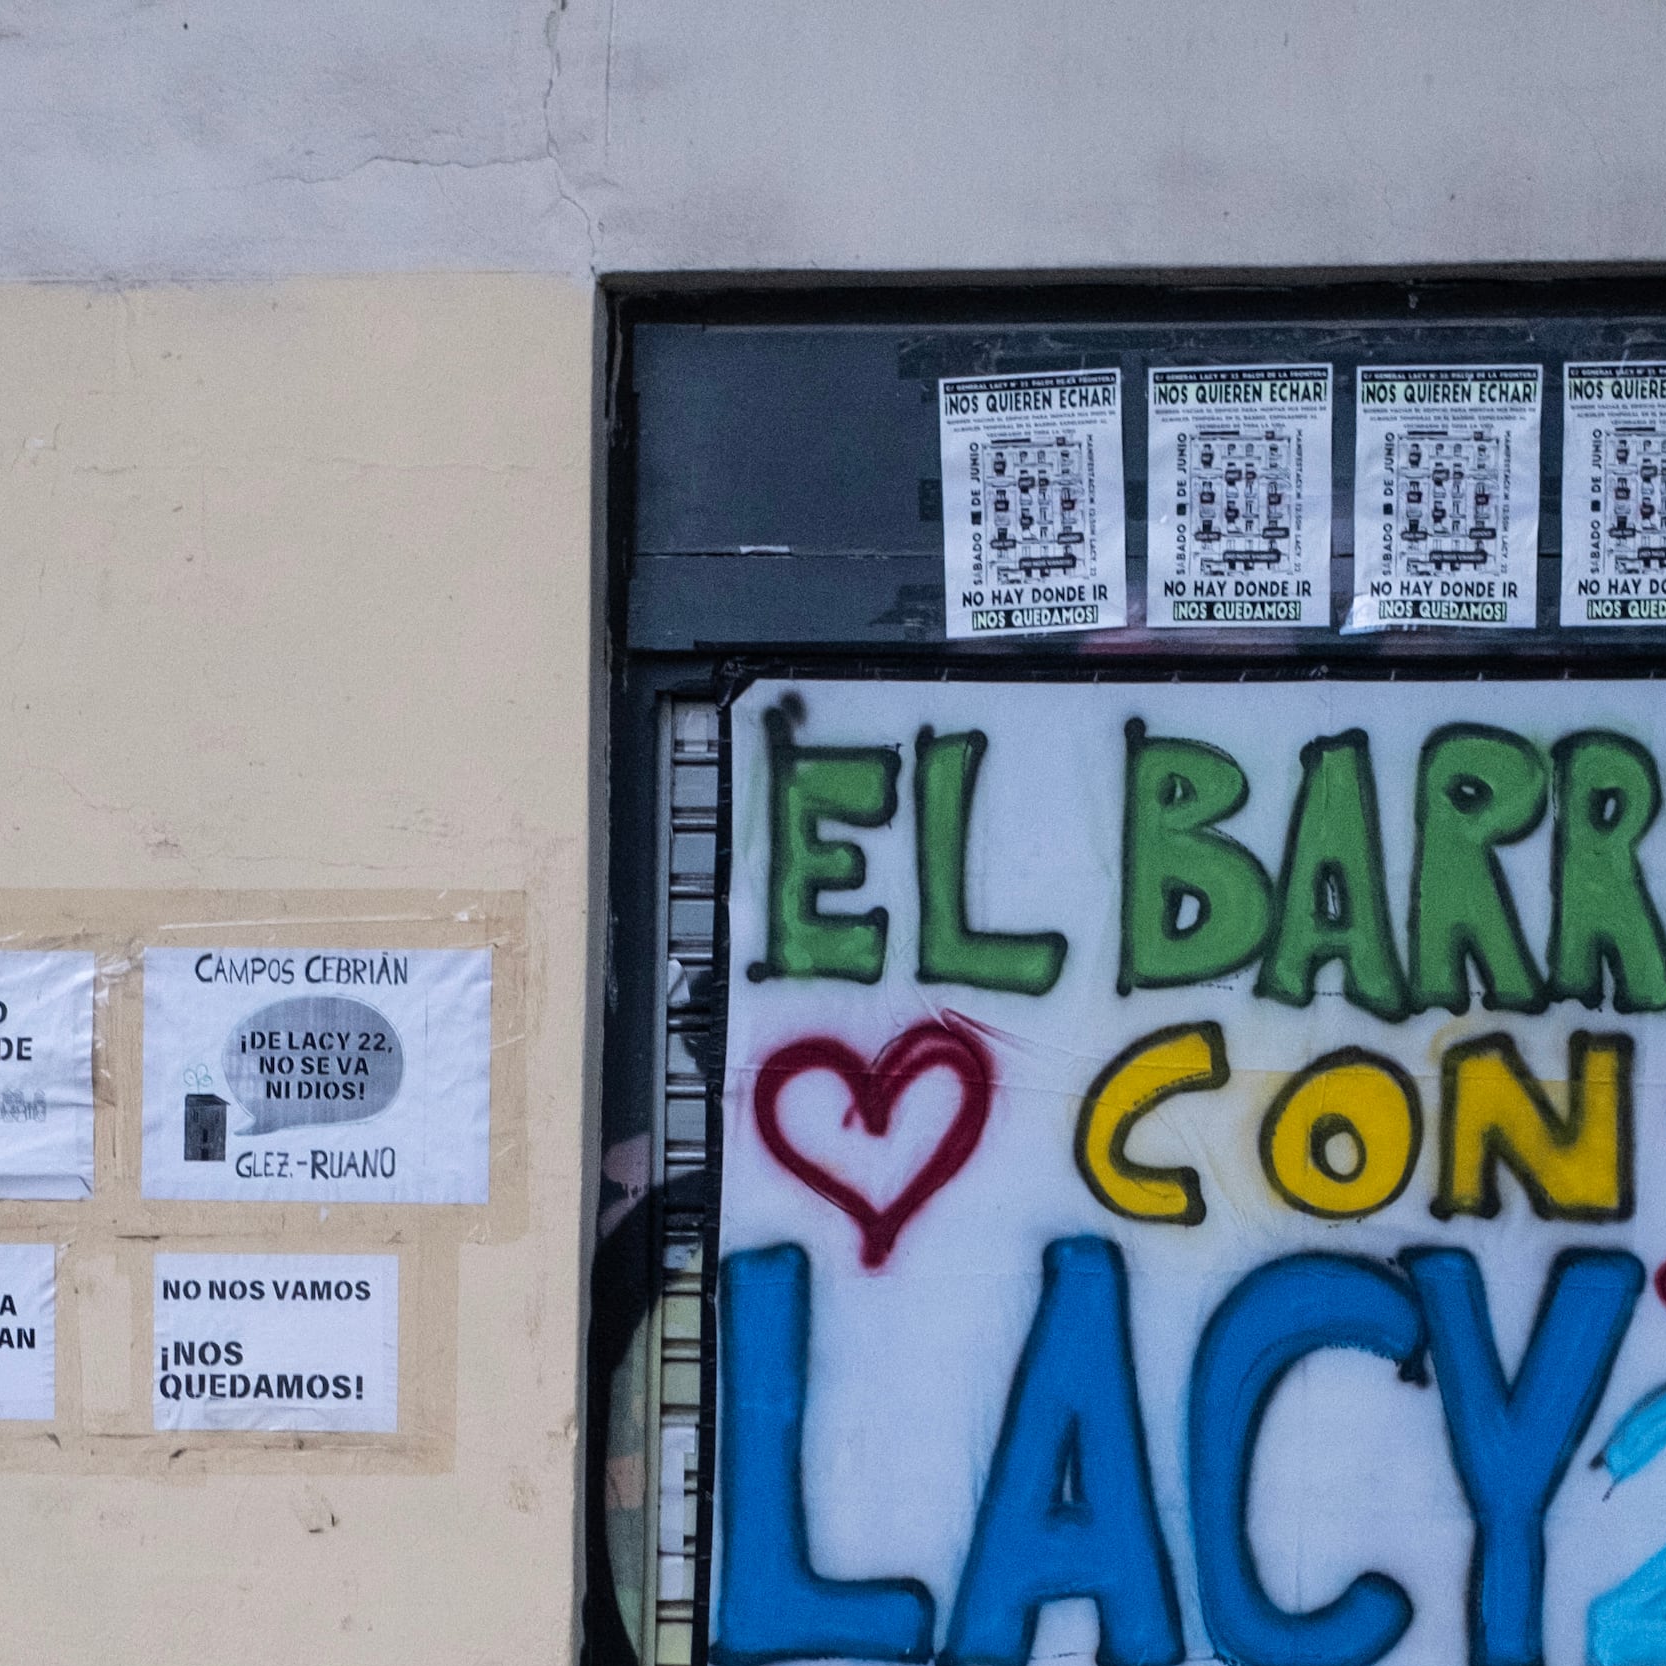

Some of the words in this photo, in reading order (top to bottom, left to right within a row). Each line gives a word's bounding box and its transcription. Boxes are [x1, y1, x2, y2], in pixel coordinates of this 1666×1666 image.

[1153, 384, 1188, 405] ¡NOS
[1196, 383, 1262, 404] QUIEREN
[1270, 382, 1327, 402] ECHAR!
[1361, 383, 1396, 404] ¡NOS
[1404, 383, 1471, 403] QUIEREN
[1479, 383, 1537, 403] ECHAR!
[1568, 379, 1604, 400] ¡NOS
[945, 394, 979, 416] ¡NOS
[986, 389, 1052, 413] QUIEREN
[1059, 387, 1116, 409] ECHAR!
[1177, 432, 1187, 474] JUNIO
[1384, 432, 1395, 474] JUNIO
[1592, 429, 1602, 469] JUNIO
[969, 442, 981, 483] JUNIO
[1177, 480, 1187, 497] DE
[1383, 480, 1393, 497] DE
[1591, 476, 1601, 493] DE
[971, 490, 981, 506] DE
[962, 591, 984, 608] NO
[991, 588, 1024, 606] HAY
[1033, 586, 1085, 604] DONDE
[1092, 584, 1108, 601] IR
[1164, 581, 1186, 597] NO
[1194, 580, 1226, 597] HAY
[1235, 581, 1289, 597] DONDE
[1296, 581, 1311, 597] IR
[1370, 582, 1392, 597] NO
[1400, 581, 1432, 596] HAY
[1441, 582, 1495, 597] DONDE
[1502, 582, 1518, 598] IR
[1578, 579, 1600, 595] NO
[1608, 579, 1641, 595] HAY
[973, 611, 1006, 628] ¡NOS
[1011, 606, 1098, 626] QUEDAMOS!
[1174, 602, 1207, 619] ¡NOS
[1213, 602, 1300, 619] QUEDAMOS!
[1380, 601, 1413, 619] ¡NOS
[1419, 601, 1507, 621] QUEDAMOS!
[1587, 600, 1622, 618] ¡NOS
[746, 705, 1069, 998] EL
[194, 952, 295, 986] CAMPOS
[304, 951, 408, 986] CEBRIÁN
[241, 1031, 281, 1054] ¡DE
[288, 1031, 351, 1051] LACY
[259, 1055, 295, 1075] NO
[300, 1056, 330, 1076] SE
[336, 1056, 369, 1076] VA
[266, 1080, 290, 1099] NI
[297, 1080, 365, 1101] DIOS!
[1074, 1019, 1636, 1225] CON
[162, 1279, 202, 1301] NO
[208, 1279, 266, 1301] NOS
[272, 1280, 371, 1301] VAMOS
[161, 1340, 244, 1372] ¡NOS
[159, 1373, 363, 1401] QUEDAMOS!
